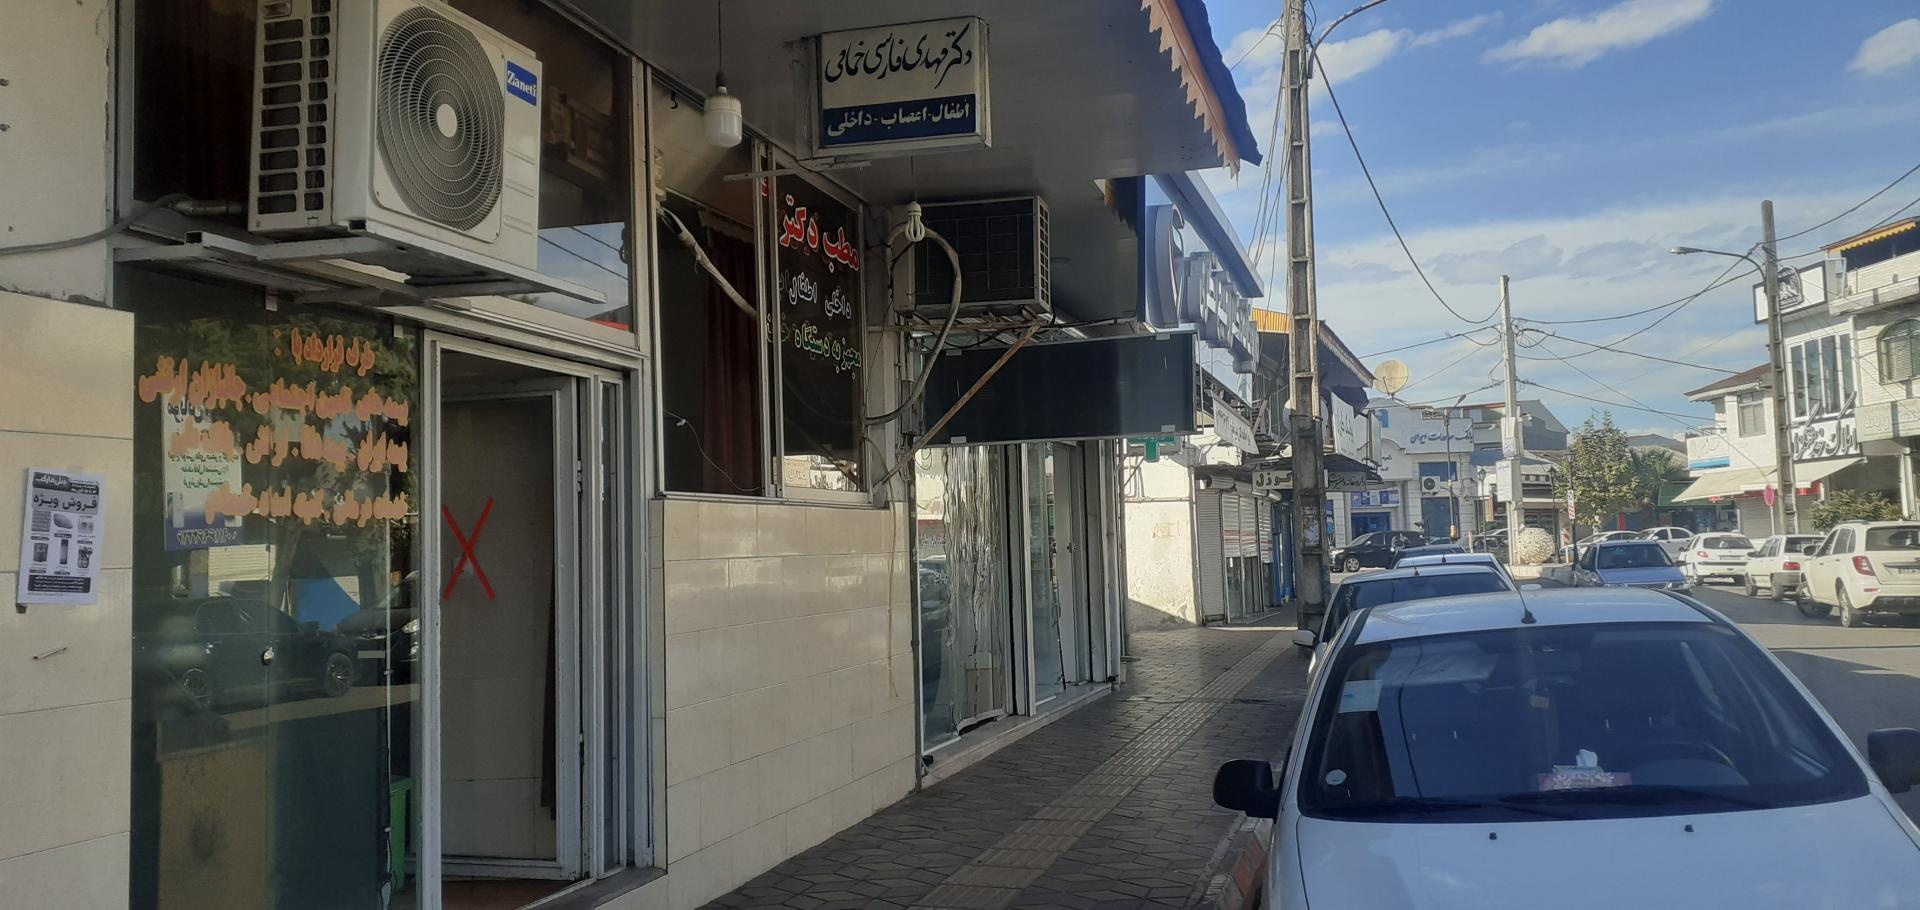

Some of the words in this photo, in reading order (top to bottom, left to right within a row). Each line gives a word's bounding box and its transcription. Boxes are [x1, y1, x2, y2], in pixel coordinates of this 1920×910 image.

[863, 32, 904, 80] فارسی
[903, 33, 949, 74] مهدی
[934, 22, 973, 90] دکتر
[507, 70, 537, 97] Zaneti
[826, 108, 873, 137] داخلی
[880, 106, 928, 130] اعصاب
[931, 101, 971, 123] اطفال
[779, 193, 818, 249] دکتر
[822, 226, 860, 274] مطب
[1409, 432, 1428, 445] ایران
[1427, 432, 1455, 442] صدرات
[1455, 422, 1474, 444] بانک
[33, 494, 59, 509] ویژه
[62, 495, 97, 512] فروش
